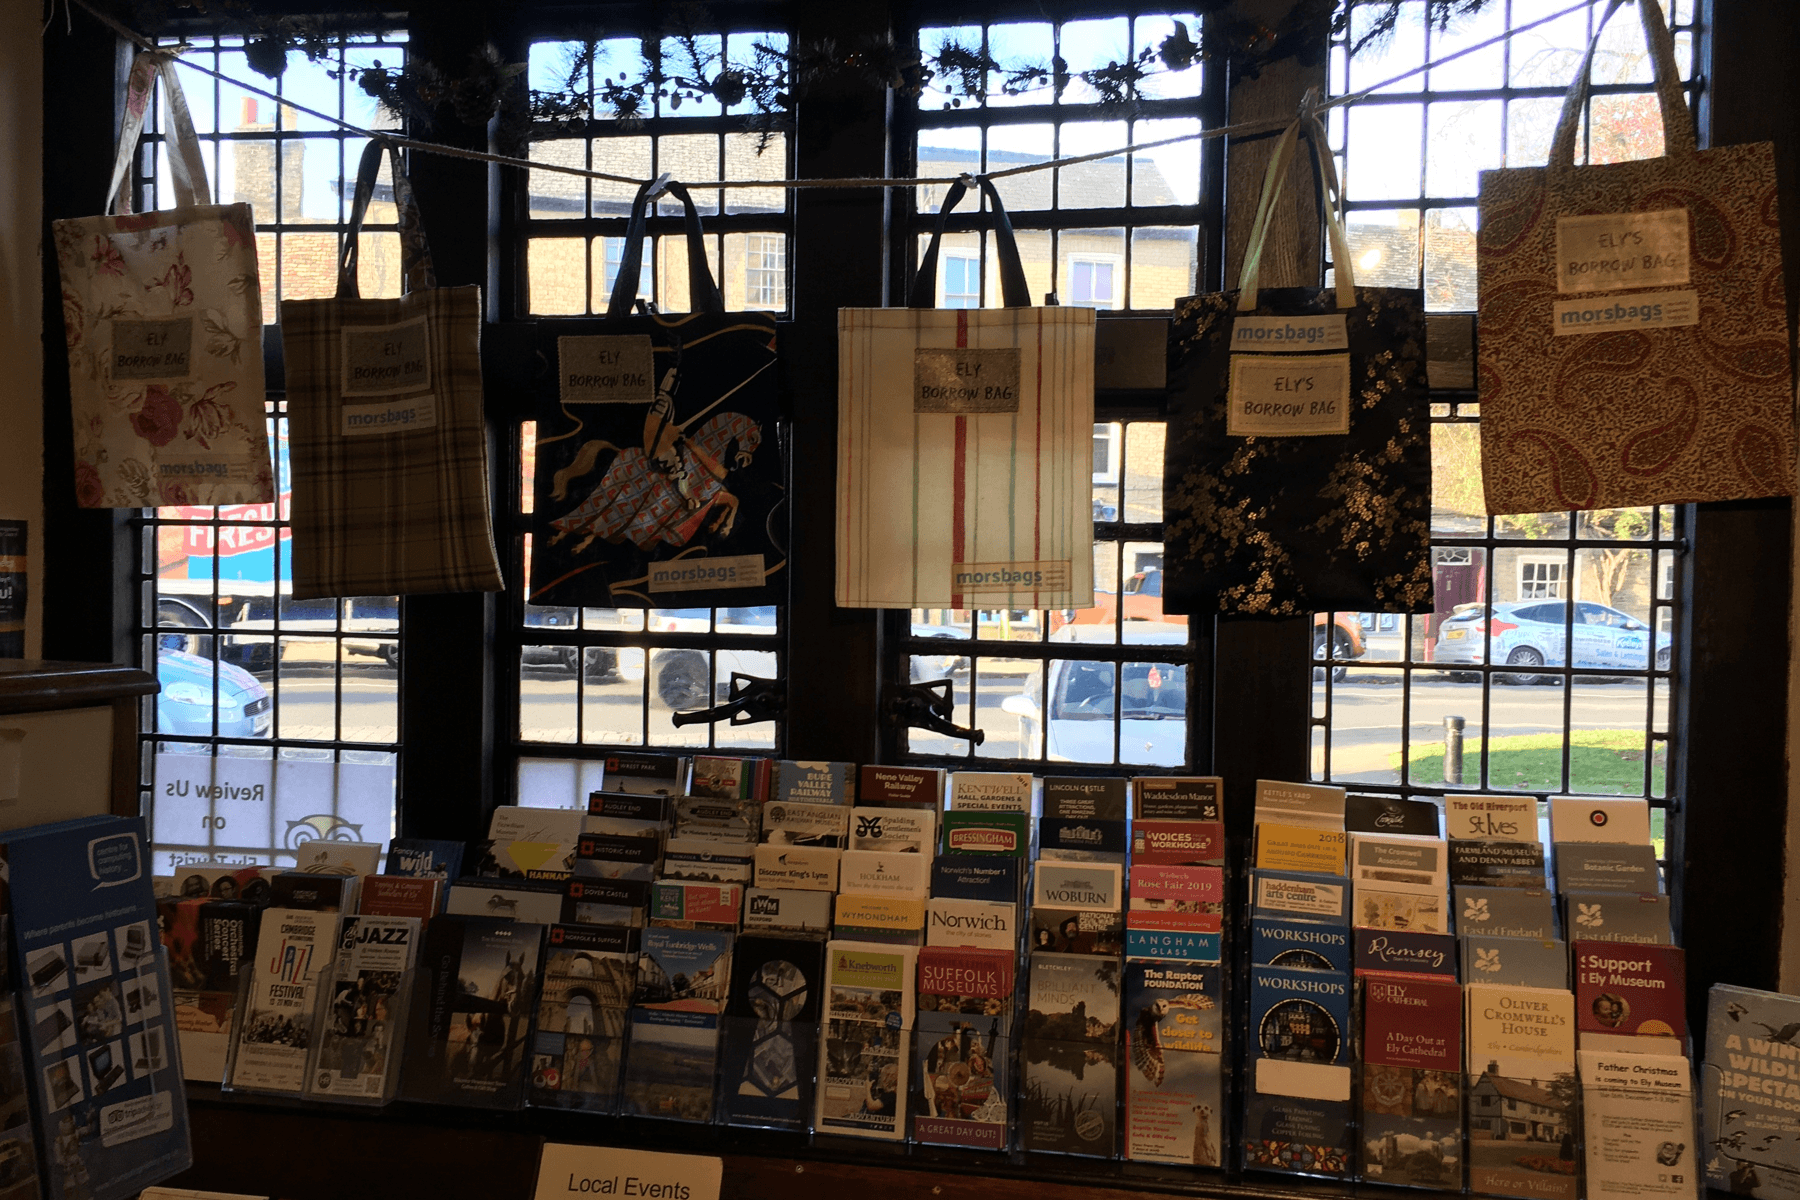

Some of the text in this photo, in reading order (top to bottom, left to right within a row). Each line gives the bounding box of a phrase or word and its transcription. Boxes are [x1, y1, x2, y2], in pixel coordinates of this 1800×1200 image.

[1599, 231, 1643, 249] ELY'S
[1568, 252, 1676, 276] BORROW BAG
[1561, 303, 1663, 324] morsbags
[145, 332, 167, 347] ELY
[1237, 324, 1325, 343] morsbags
[384, 342, 402, 356] ELY
[118, 352, 185, 368] BORROW BAG
[599, 350, 620, 365] ELY
[355, 360, 423, 380] BORROW BAG
[957, 362, 981, 378] ELY
[569, 373, 646, 388] BORROW BAG
[1274, 376, 1314, 393] ELY'S
[922, 386, 1012, 401] BORROW BAG
[1244, 400, 1336, 416] BORROW BAG
[348, 409, 416, 424] morsbags
[160, 461, 228, 477] morsbags
[653, 565, 737, 583] morsbags
[956, 568, 1043, 586] morsbags
[640, 764, 657, 772] PARK
[807, 772, 833, 781] BURE
[875, 772, 924, 785] Nene Valley
[797, 780, 833, 789] VALLEY
[884, 780, 916, 793] Railway
[957, 783, 1023, 795] KENTWELL
[1049, 784, 1080, 792] LINCOLN
[789, 788, 833, 797] RAILWAY
[1143, 791, 1214, 801] Waddesdon Manor
[1293, 791, 1311, 799] YARD
[1453, 801, 1528, 813] The Old Riverport
[787, 809, 841, 820] EAST ANGLIAN
[882, 816, 915, 825] Spalding
[882, 824, 921, 833] Gentlemen's
[1468, 812, 1519, 836] St Ives
[882, 832, 910, 841] Society
[953, 832, 1013, 844] BRESSINGHAM
[1318, 832, 1345, 844] 2018
[392, 846, 415, 857] Fancy
[1455, 847, 1541, 857] FARMLAND MUSEUM
[399, 850, 434, 873] wild
[1459, 856, 1536, 866] AND DENNY ABBEY
[1583, 863, 1646, 873] Botanic Garden
[758, 868, 829, 880] Discover King's Lynn
[860, 873, 900, 882] HOLKHAM
[1138, 879, 1213, 892] Rose Fair 2019
[1265, 881, 1316, 894] haddenham
[584, 889, 629, 899] DOVER CASTLE
[1046, 890, 1107, 904] WOBURN
[1265, 890, 1317, 903] arts centre
[841, 911, 909, 923] WYMONDHAM
[931, 910, 1007, 931] Norwich
[213, 918, 222, 951] Series
[281, 924, 316, 937] CAMBRIDGE
[355, 927, 411, 946] JAZZ
[1260, 927, 1346, 946] WORKSHOPS
[1463, 925, 1544, 938] East of England
[221, 919, 230, 962] Concert
[647, 939, 717, 951] Royal Tunbridge Wells
[1129, 934, 1209, 948] LANGHAM
[1601, 932, 1613, 942] of
[1614, 933, 1658, 945] England
[228, 919, 239, 976] Orchestral
[1150, 947, 1188, 956] GLASS
[1367, 936, 1447, 968] Ramsey
[269, 938, 315, 985] JAZZ
[848, 958, 897, 973] Knebworth
[1588, 954, 1652, 973] Support
[923, 965, 997, 984] SUFFOLK
[1143, 968, 1205, 982] The Raptor
[1588, 972, 1666, 989] Ely Museum
[922, 980, 999, 996] MUSEUMS
[1037, 980, 1099, 994] BRILLIANT
[1143, 979, 1205, 991] FOUNDATION
[1258, 975, 1346, 996] WORKSHOPS
[1387, 984, 1408, 998] ELY
[269, 985, 305, 1001] FESTIVAL
[1036, 993, 1077, 1006] MINDS
[1387, 997, 1429, 1007] CATHEDRAL
[1498, 996, 1551, 1012] OLIVER
[1175, 1013, 1200, 1026] Get
[1483, 1007, 1567, 1026] CROMWELL'S
[1161, 1025, 1214, 1040] closer to
[1501, 1022, 1549, 1037] HOUSE
[1163, 1040, 1213, 1052] wildlife
[1386, 1032, 1446, 1046] A Day Out at
[1386, 1043, 1447, 1058] Ely Cathedral
[1597, 1062, 1678, 1076] Father Christmas
[1603, 1076, 1628, 1085] coming
[1640, 1078, 1652, 1088] Ely
[1654, 1080, 1682, 1088] Museum
[1717, 1088, 1736, 1099] ON
[1737, 1091, 1773, 1107] YOUR
[919, 1124, 997, 1139] A GREAT DAY OUT!
[568, 1172, 692, 1200] Local Events
